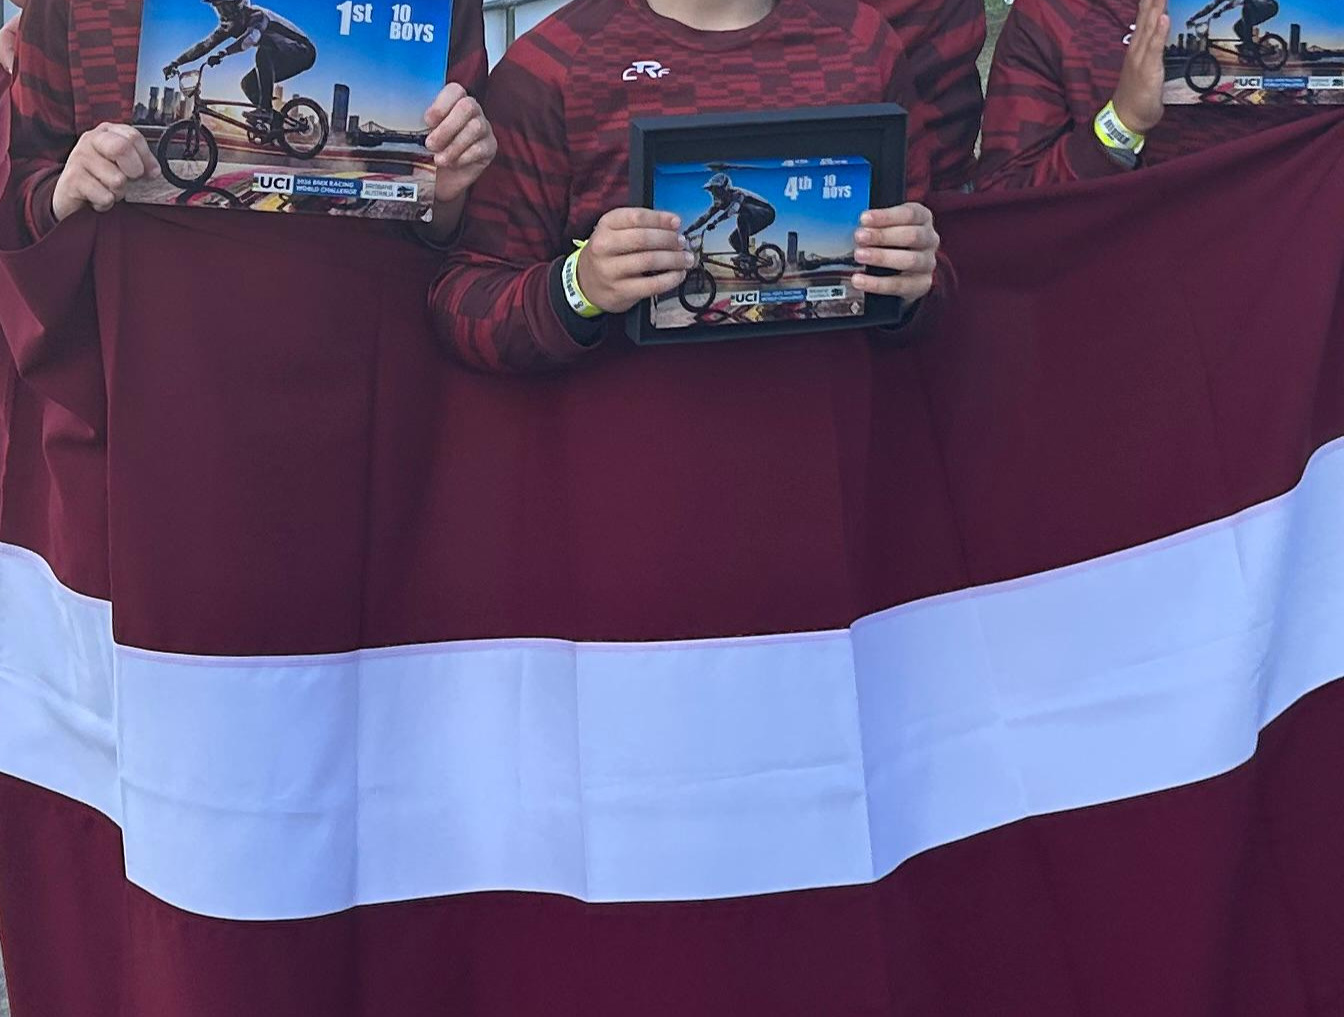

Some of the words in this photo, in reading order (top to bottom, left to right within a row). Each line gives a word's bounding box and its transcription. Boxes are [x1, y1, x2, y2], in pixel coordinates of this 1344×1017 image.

[336, 0, 372, 36] 1st
[391, 4, 412, 22] 10
[389, 20, 434, 43] BOYS
[1239, 77, 1261, 87] UCI
[260, 176, 290, 191] UCI
[329, 180, 354, 189] RACING
[784, 176, 812, 200] 4th
[824, 174, 836, 186] 10
[822, 185, 852, 199] BOYS
[736, 293, 758, 303] UCI
